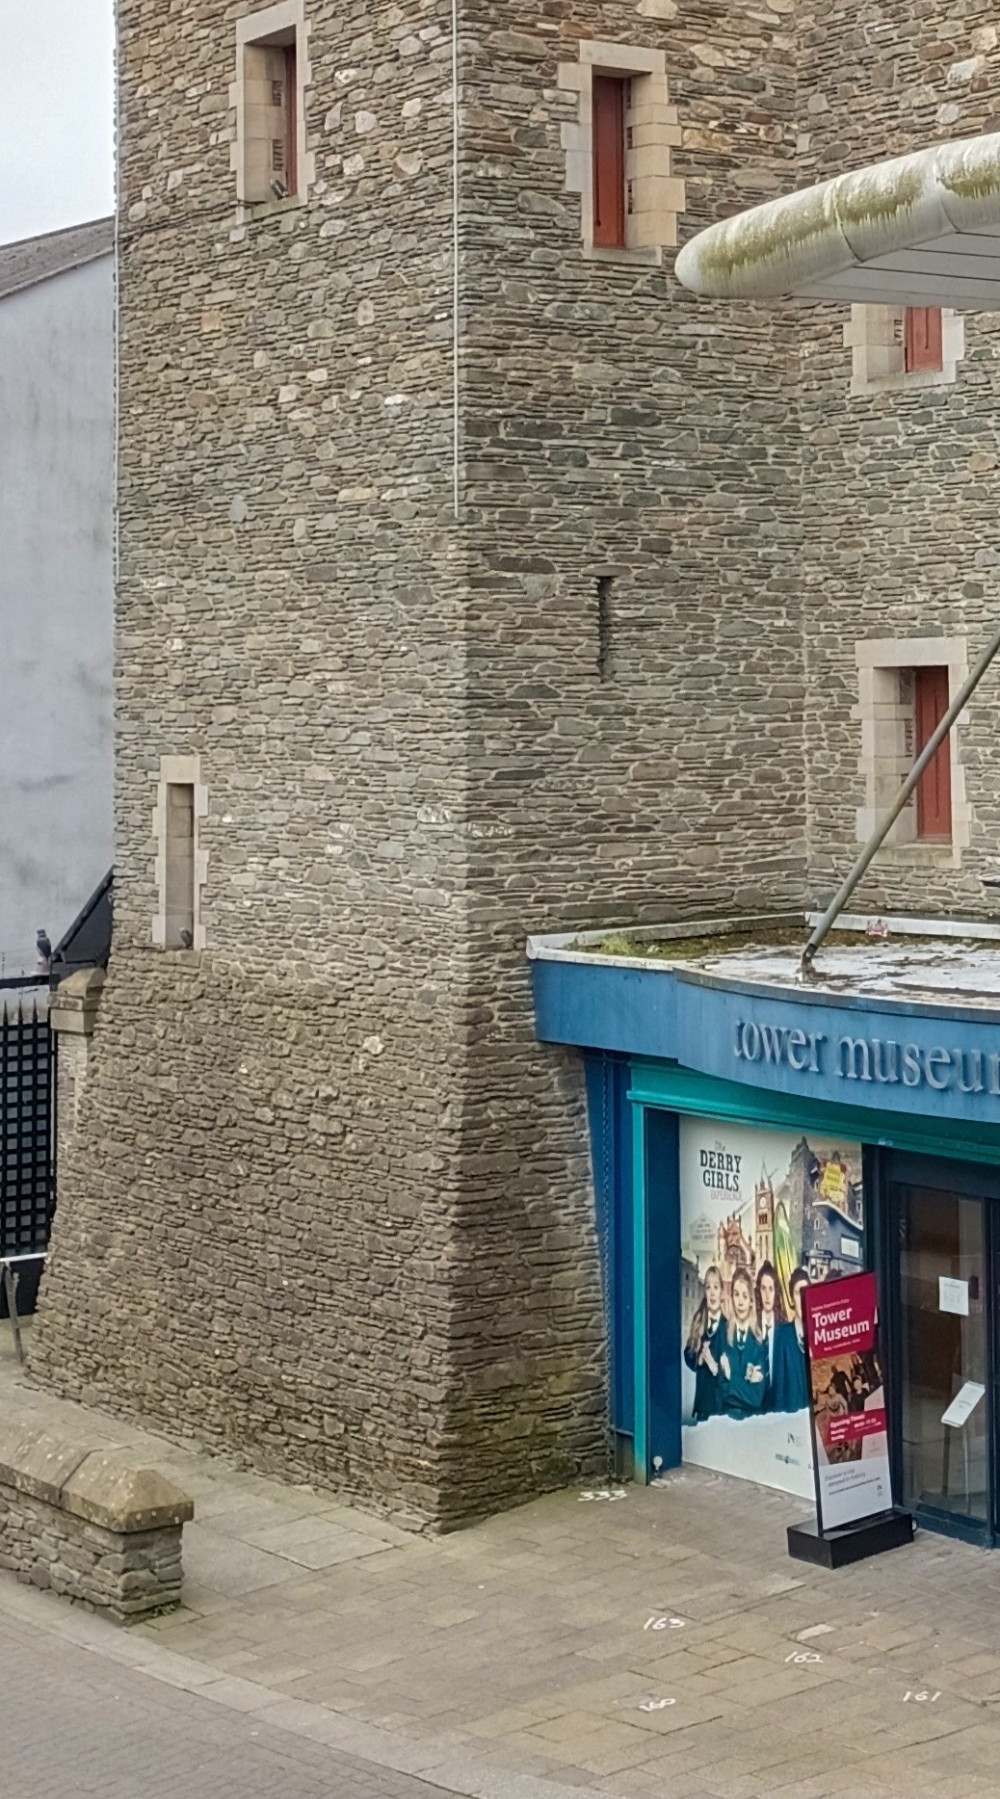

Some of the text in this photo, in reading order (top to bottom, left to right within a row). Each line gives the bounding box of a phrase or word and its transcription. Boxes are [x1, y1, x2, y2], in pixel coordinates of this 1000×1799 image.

[734, 1018, 826, 1072] tower
[699, 1149, 742, 1173] DERRY
[702, 1169, 740, 1192] GIRLS
[811, 1307, 852, 1328] Tower
[814, 1320, 870, 1346] Museum
[577, 1489, 628, 1502] 333
[643, 1617, 686, 1630] 163
[784, 1651, 824, 1663] 162
[902, 1690, 942, 1702] 161
